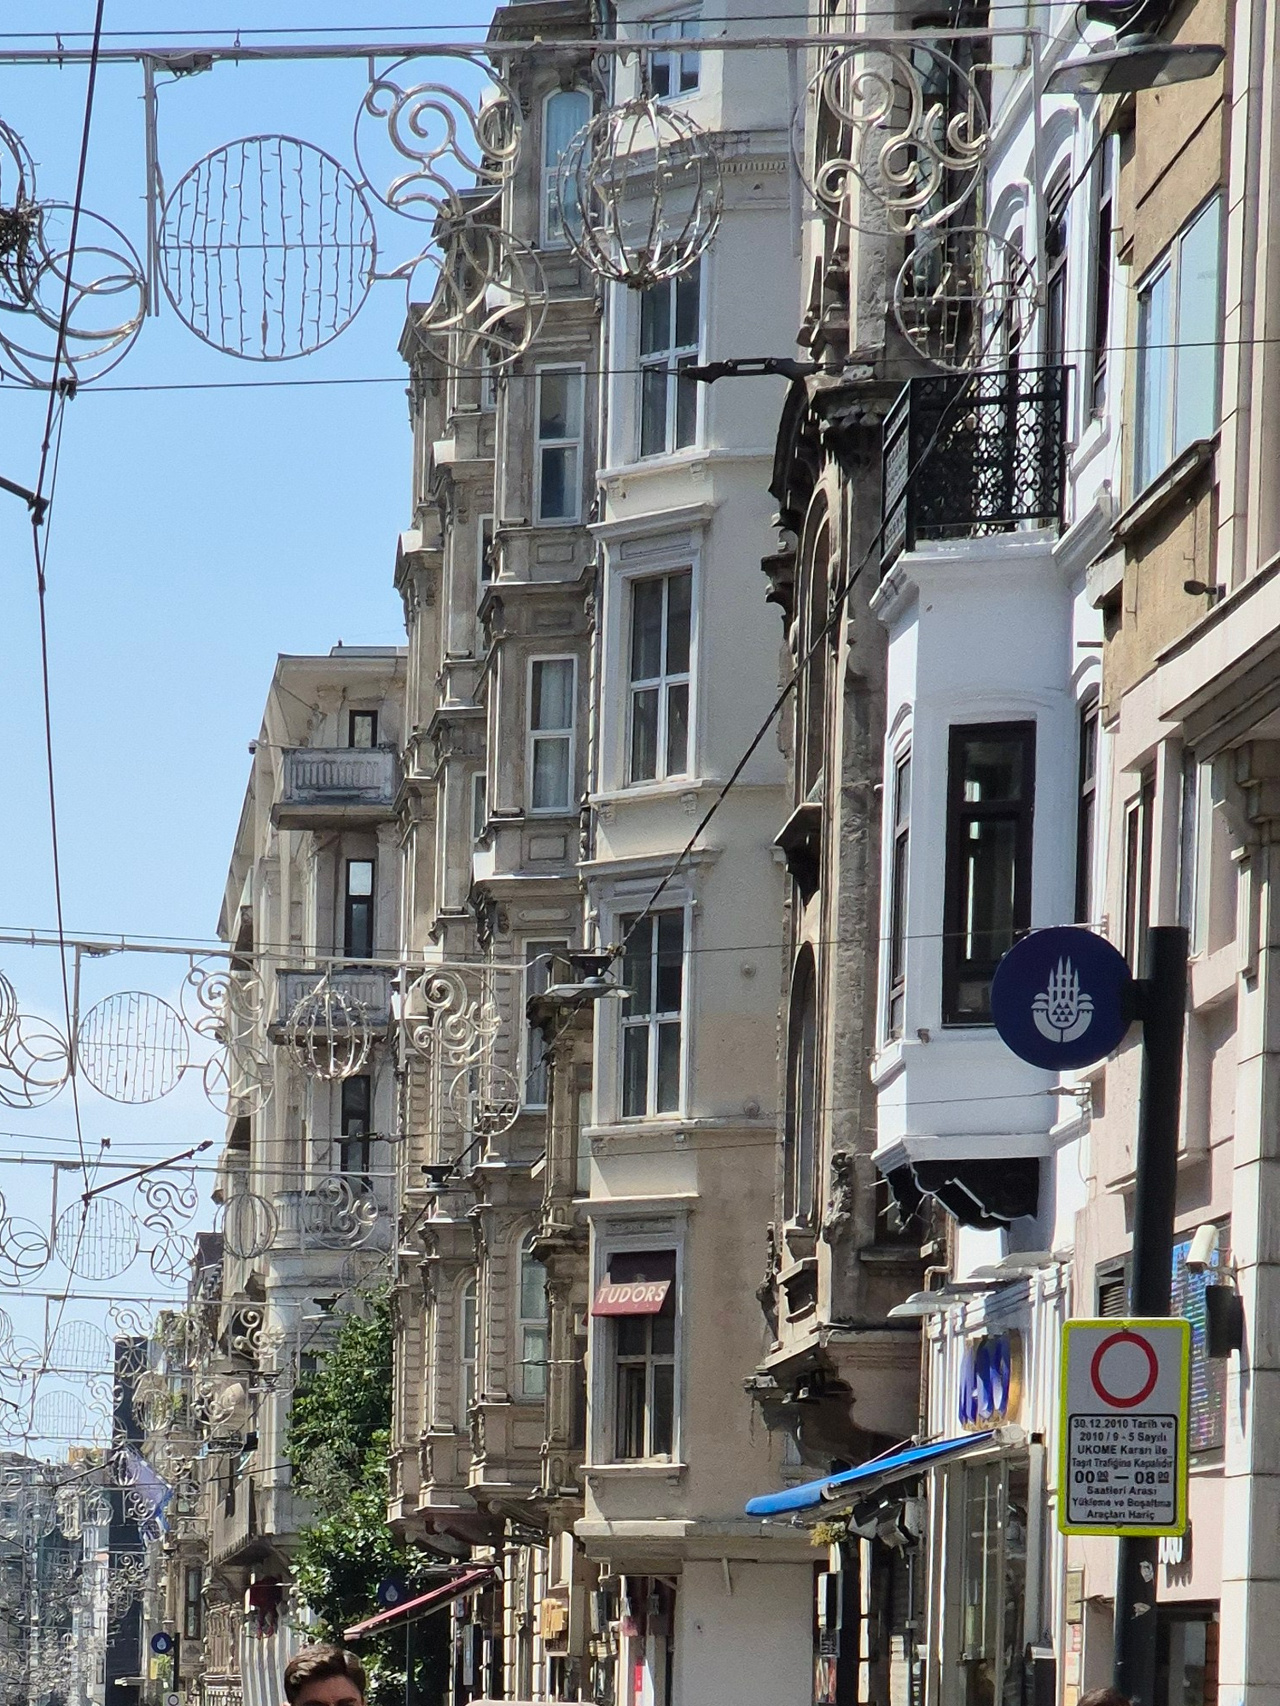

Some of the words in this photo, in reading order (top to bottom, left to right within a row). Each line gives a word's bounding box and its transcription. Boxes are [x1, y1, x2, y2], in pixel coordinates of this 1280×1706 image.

[598, 1285, 666, 1304] TUDORS
[1073, 1419, 1129, 1429] 30.12.2010
[1131, 1419, 1157, 1429] Tarih
[1160, 1421, 1173, 1429] ve
[1080, 1432, 1104, 1441] 2010
[1128, 1432, 1135, 1441] 5
[1077, 1445, 1117, 1455] UKOME
